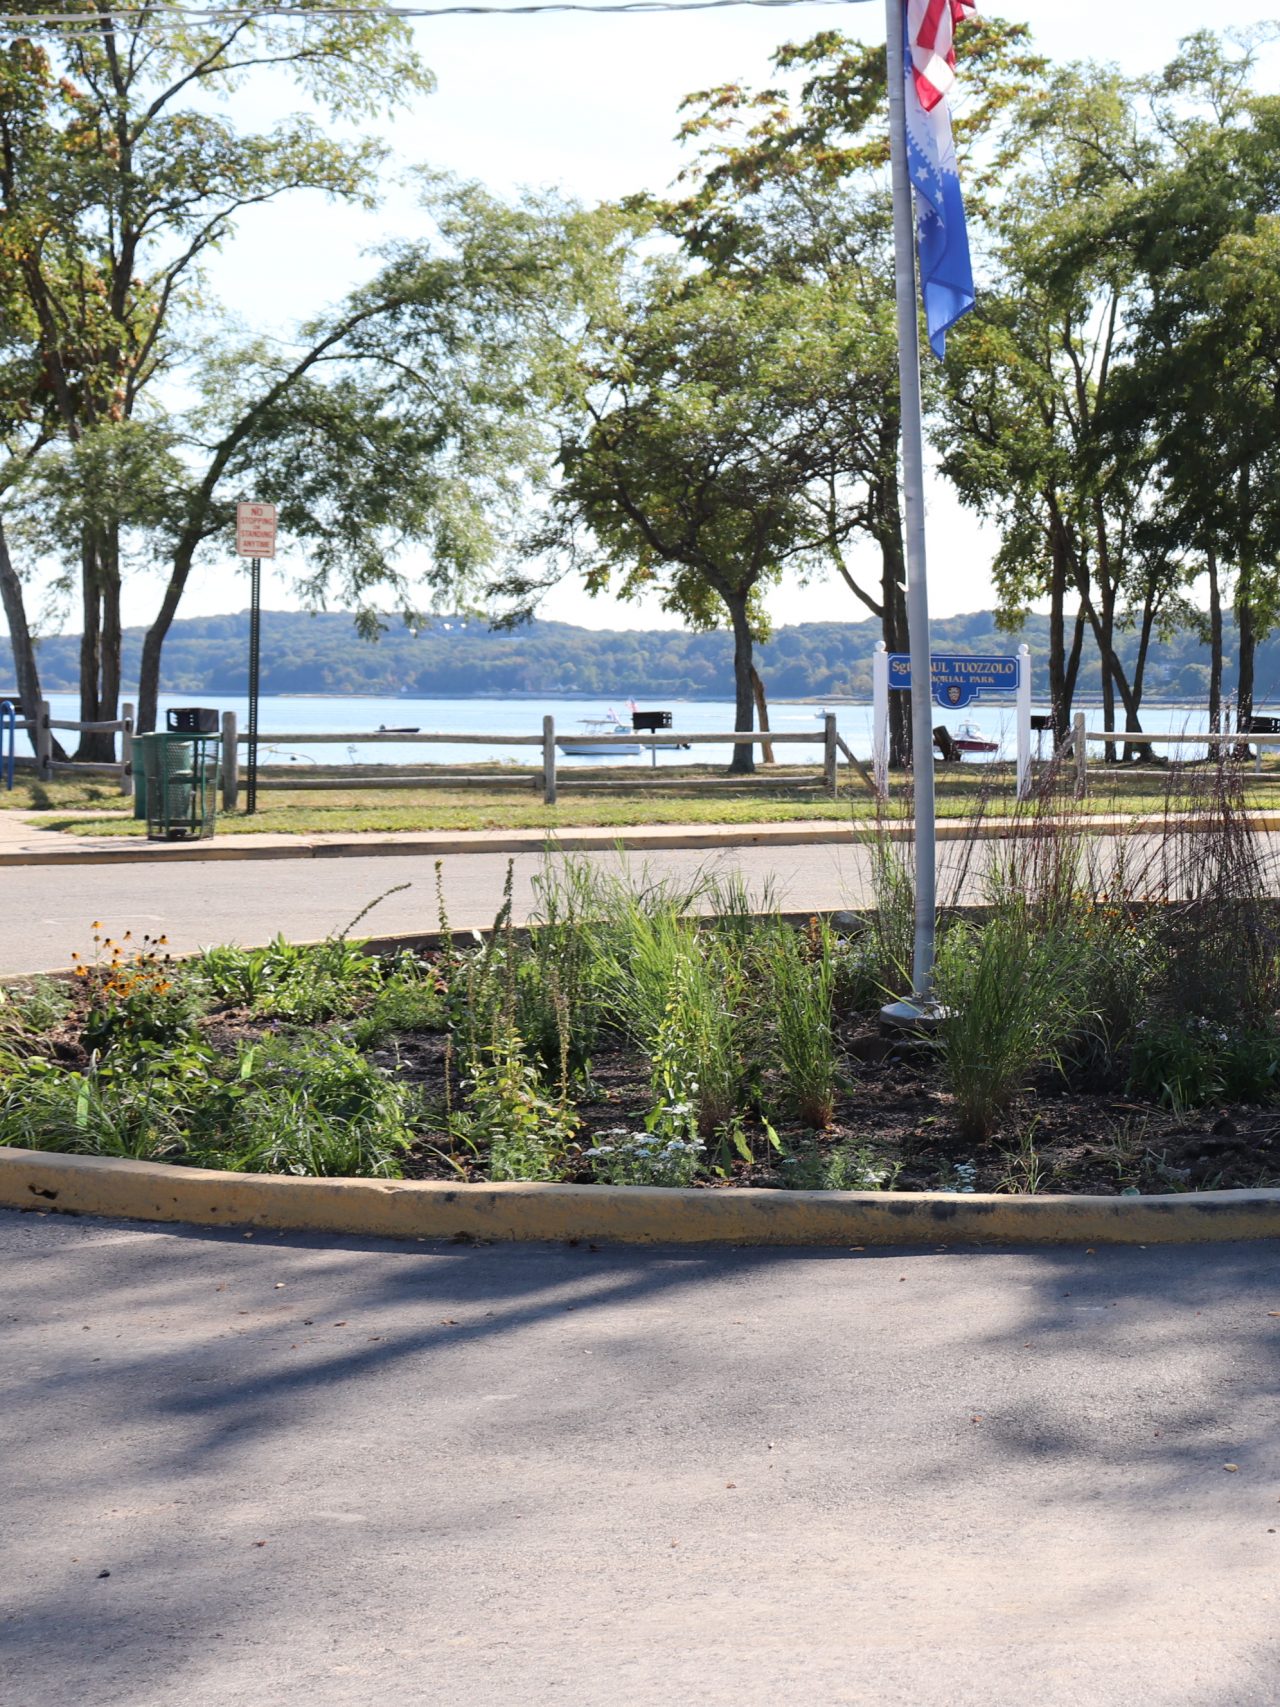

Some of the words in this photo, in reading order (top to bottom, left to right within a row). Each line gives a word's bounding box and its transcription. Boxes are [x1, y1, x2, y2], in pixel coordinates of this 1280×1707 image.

[251, 507, 263, 516] NO
[240, 517, 273, 525] STOPPING
[930, 662, 949, 673] AUL
[953, 662, 1014, 674] TUOZZOLO
